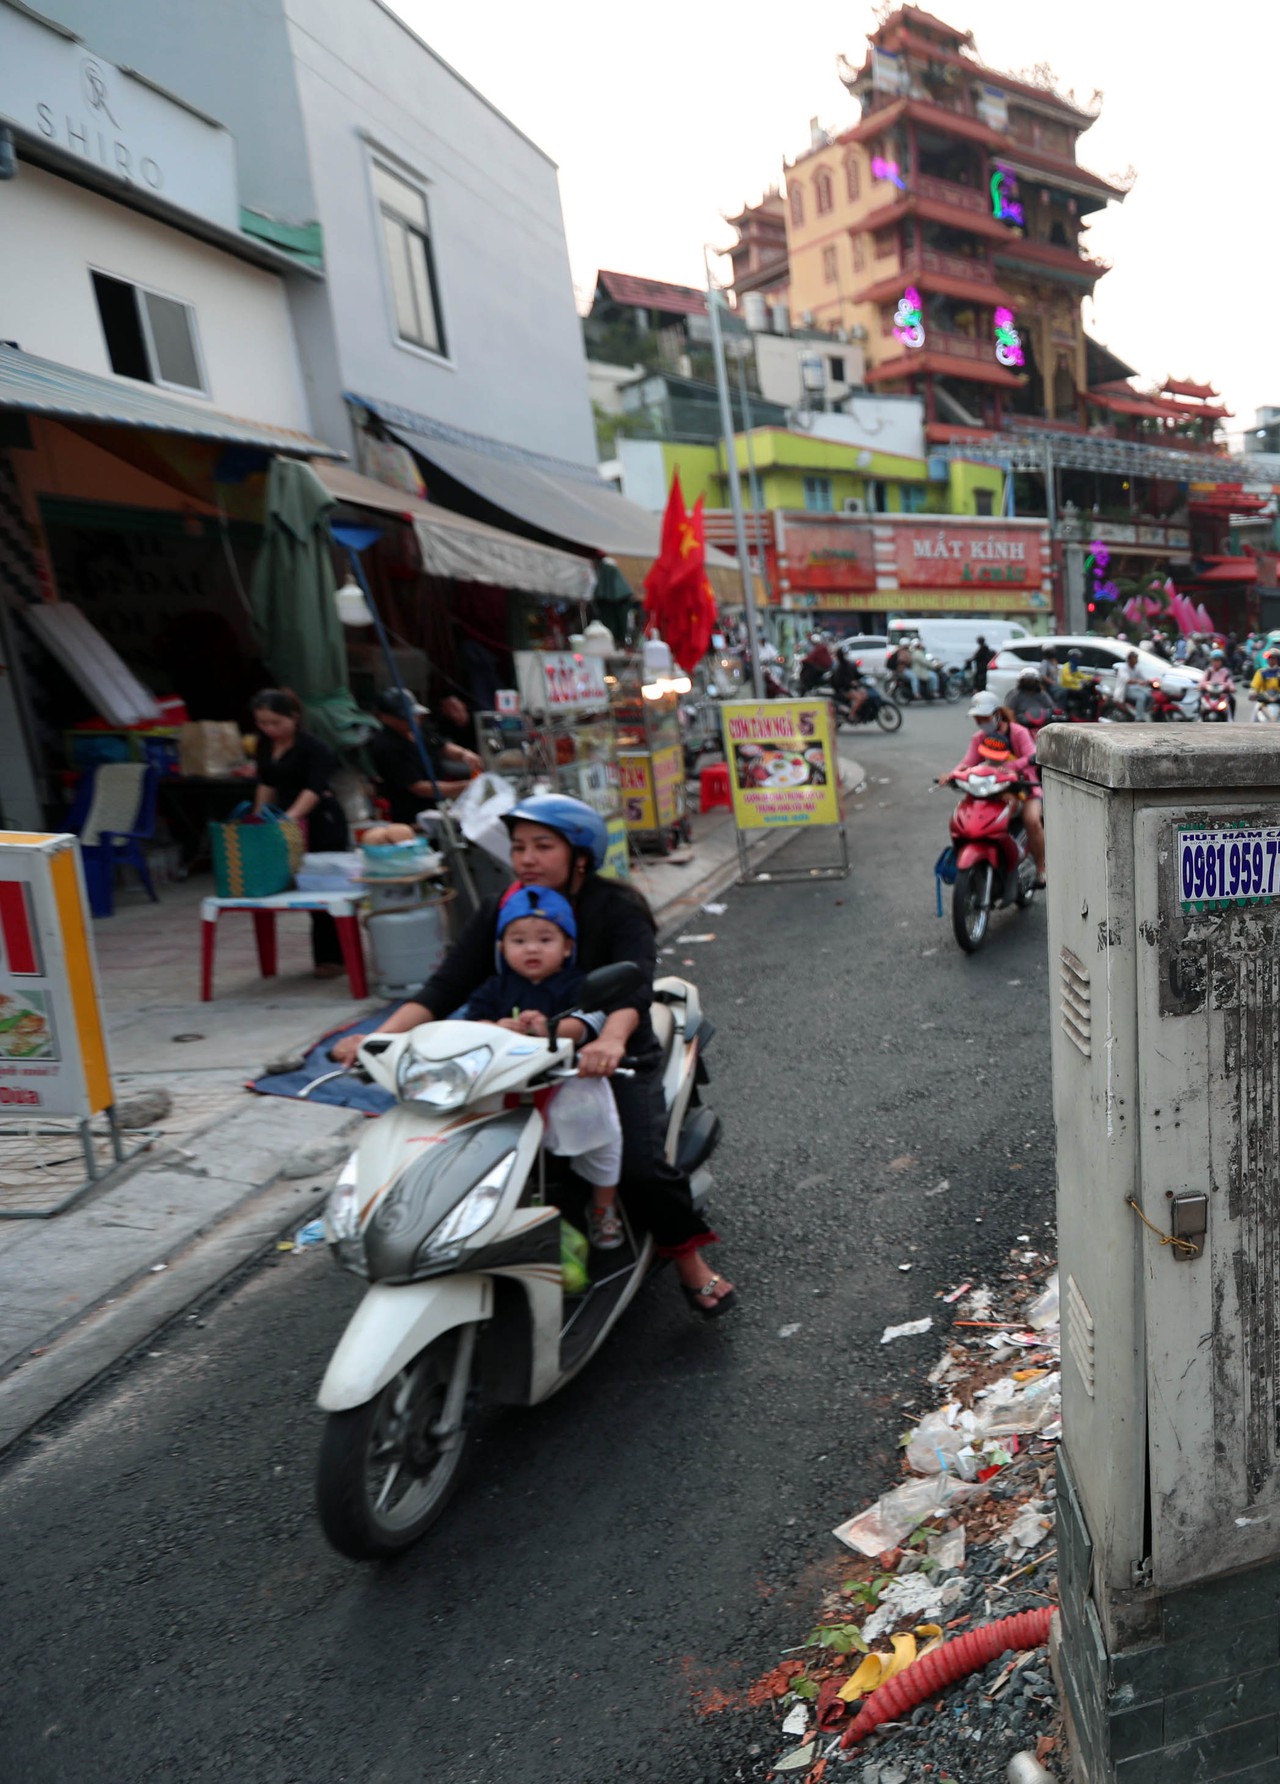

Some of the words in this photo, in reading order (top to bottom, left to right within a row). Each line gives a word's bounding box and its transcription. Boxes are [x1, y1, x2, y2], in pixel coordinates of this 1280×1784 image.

[37, 101, 165, 190] SHIRO
[913, 531, 963, 559] MẮT
[971, 536, 1025, 560] KÍNH
[797, 711, 817, 735] 5
[1183, 832, 1218, 841] HÚT
